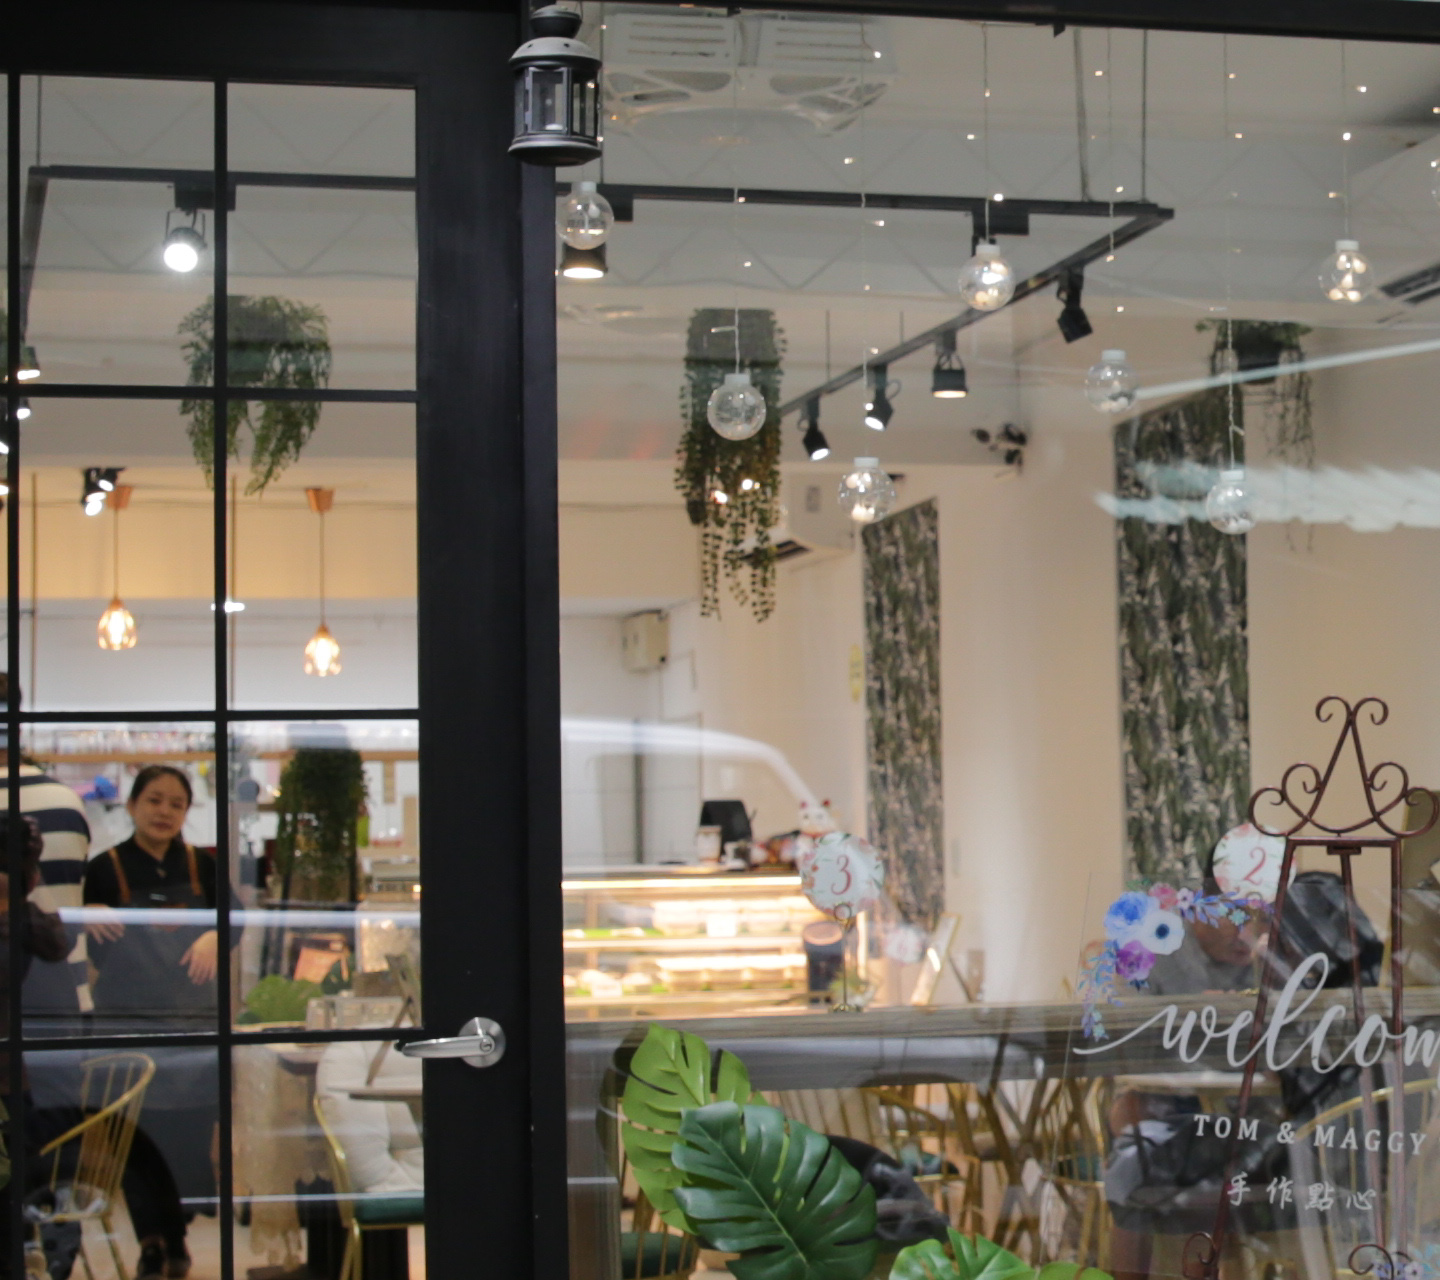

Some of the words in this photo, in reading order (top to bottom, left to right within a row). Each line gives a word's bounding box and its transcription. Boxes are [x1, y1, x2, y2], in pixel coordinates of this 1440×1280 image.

[830, 855, 853, 895] 3
[1245, 846, 1267, 884] 2
[1193, 1114, 1259, 1142] TOM
[1276, 1121, 1296, 1145] &
[1313, 1124, 1428, 1156] MAGGY
[1226, 1170, 1376, 1212] 手作點心
